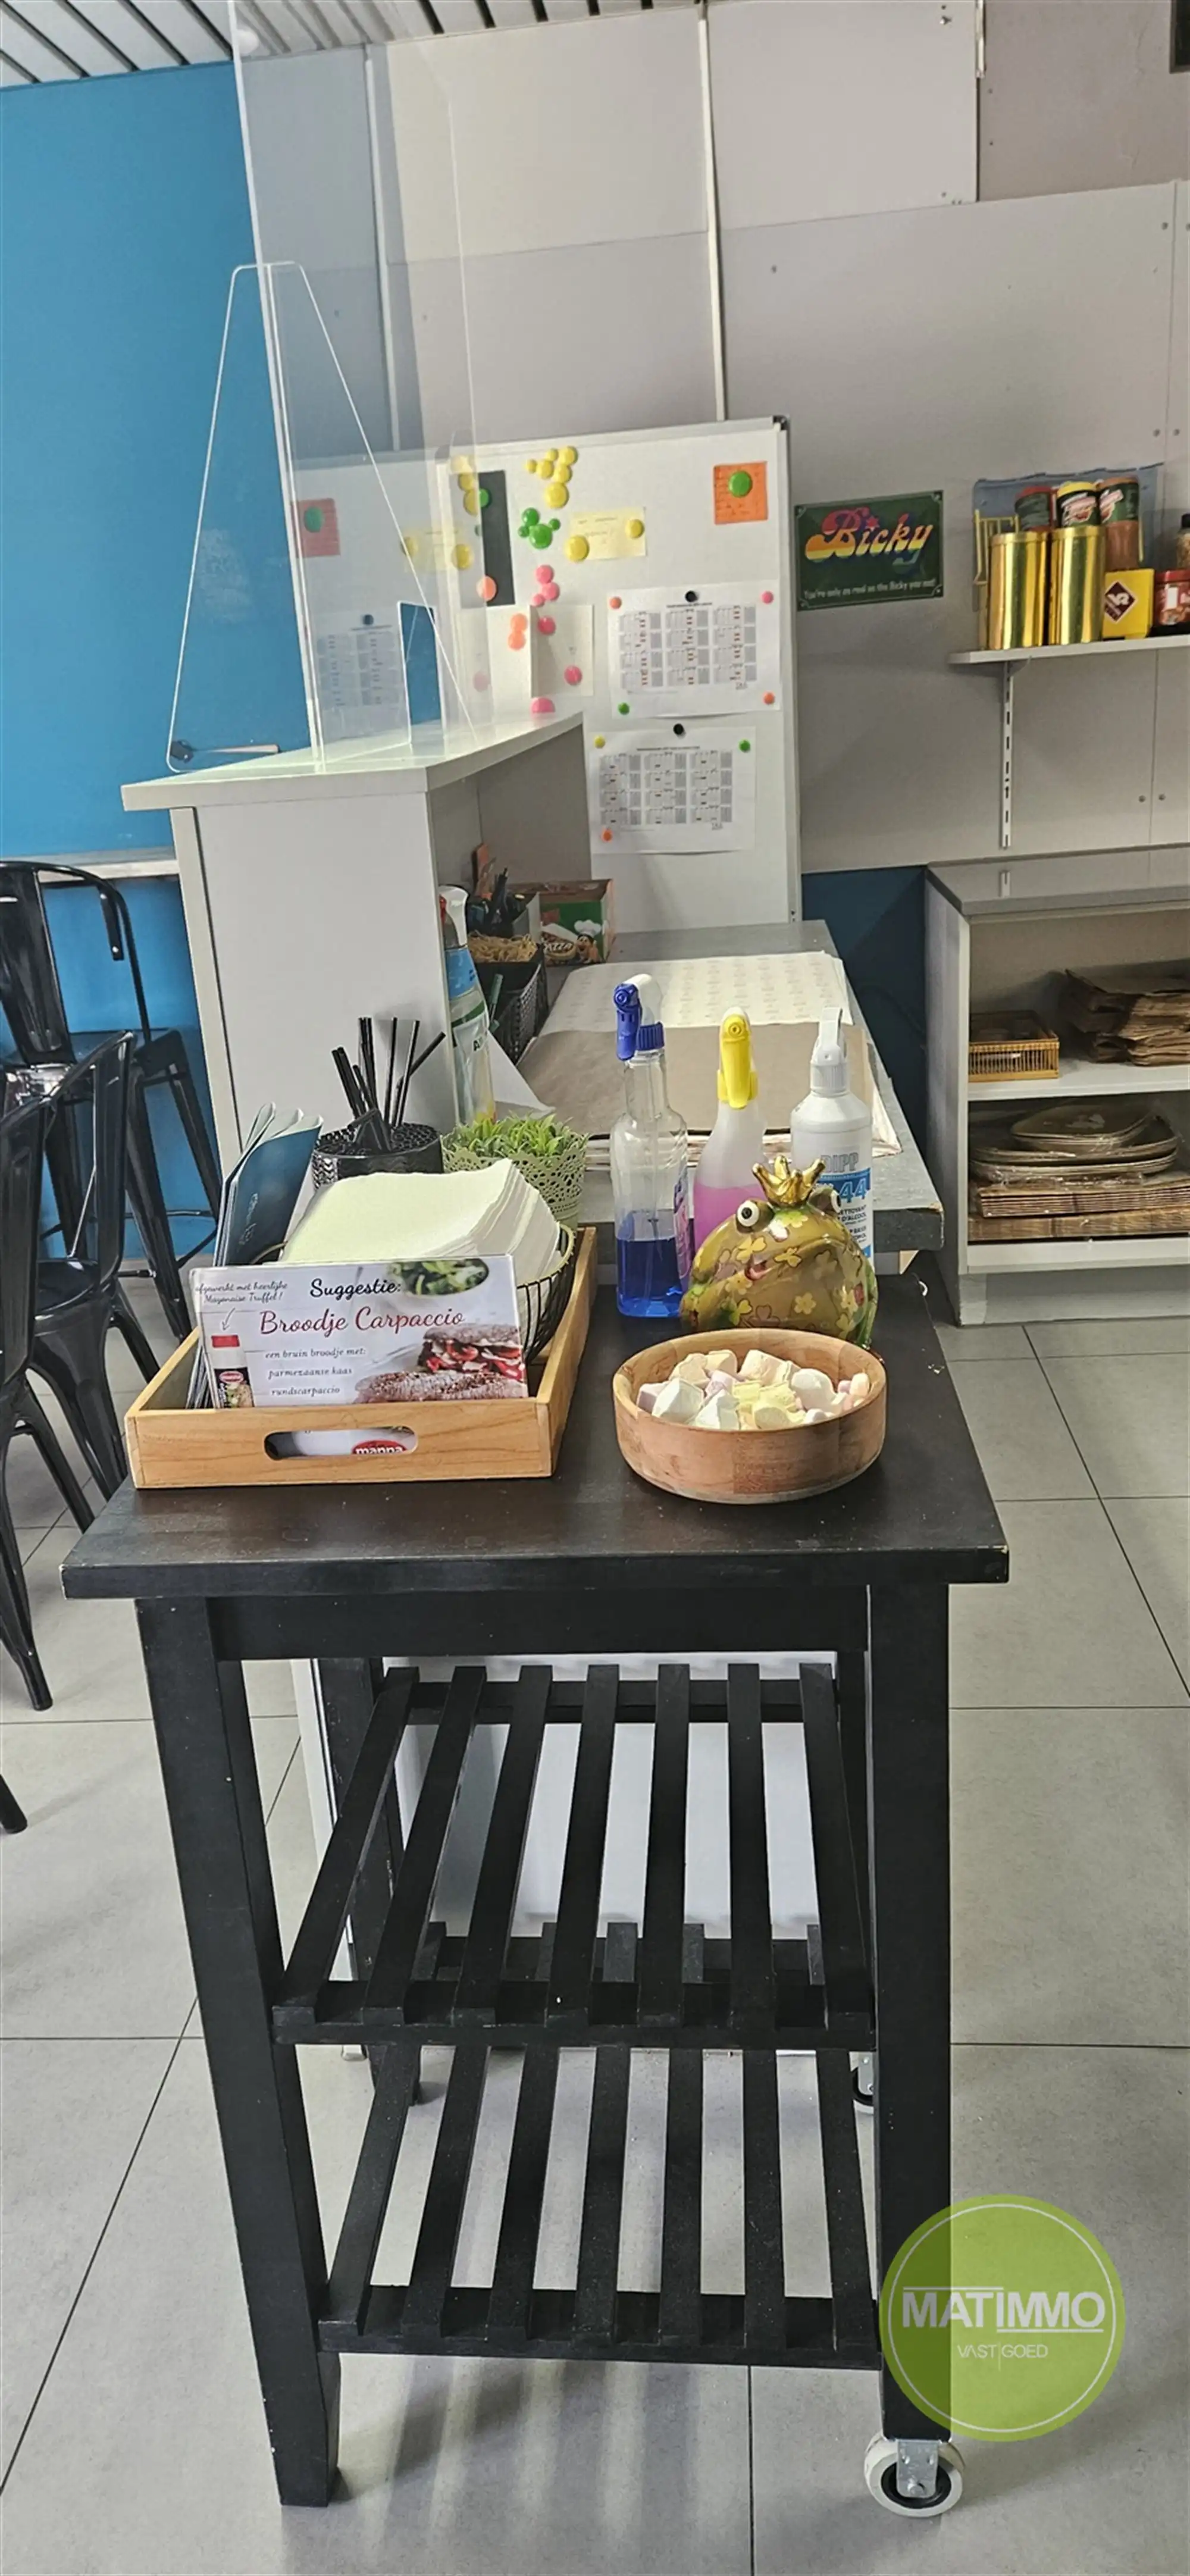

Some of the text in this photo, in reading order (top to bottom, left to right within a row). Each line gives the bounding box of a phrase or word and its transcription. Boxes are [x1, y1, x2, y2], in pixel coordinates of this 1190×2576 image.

[805, 507, 933, 574] Bicky
[310, 1278, 401, 1300] Suggestie:
[259, 1306, 465, 1338] Broodje Carpaccio
[283, 1349, 308, 1358] bruin
[311, 1346, 344, 1359] broodje
[331, 1367, 352, 1375] kaas
[271, 1385, 340, 1397] rundscarpaccio
